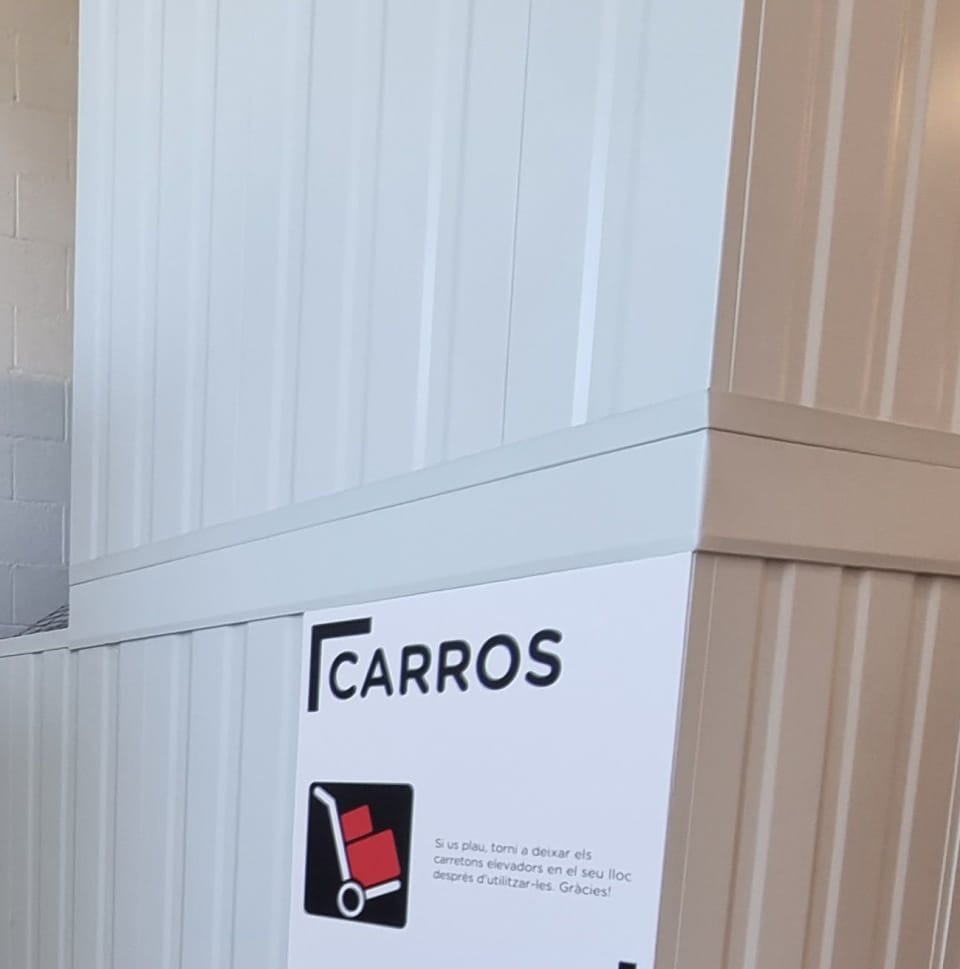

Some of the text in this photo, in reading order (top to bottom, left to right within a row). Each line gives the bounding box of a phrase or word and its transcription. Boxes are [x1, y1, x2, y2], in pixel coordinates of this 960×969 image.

[328, 628, 563, 701] CARROS
[435, 838, 592, 860] Si us plau, torni a deixar els
[433, 855, 632, 882] carretons elevadors en el seu lloc
[559, 881, 612, 898] Gràcies!
